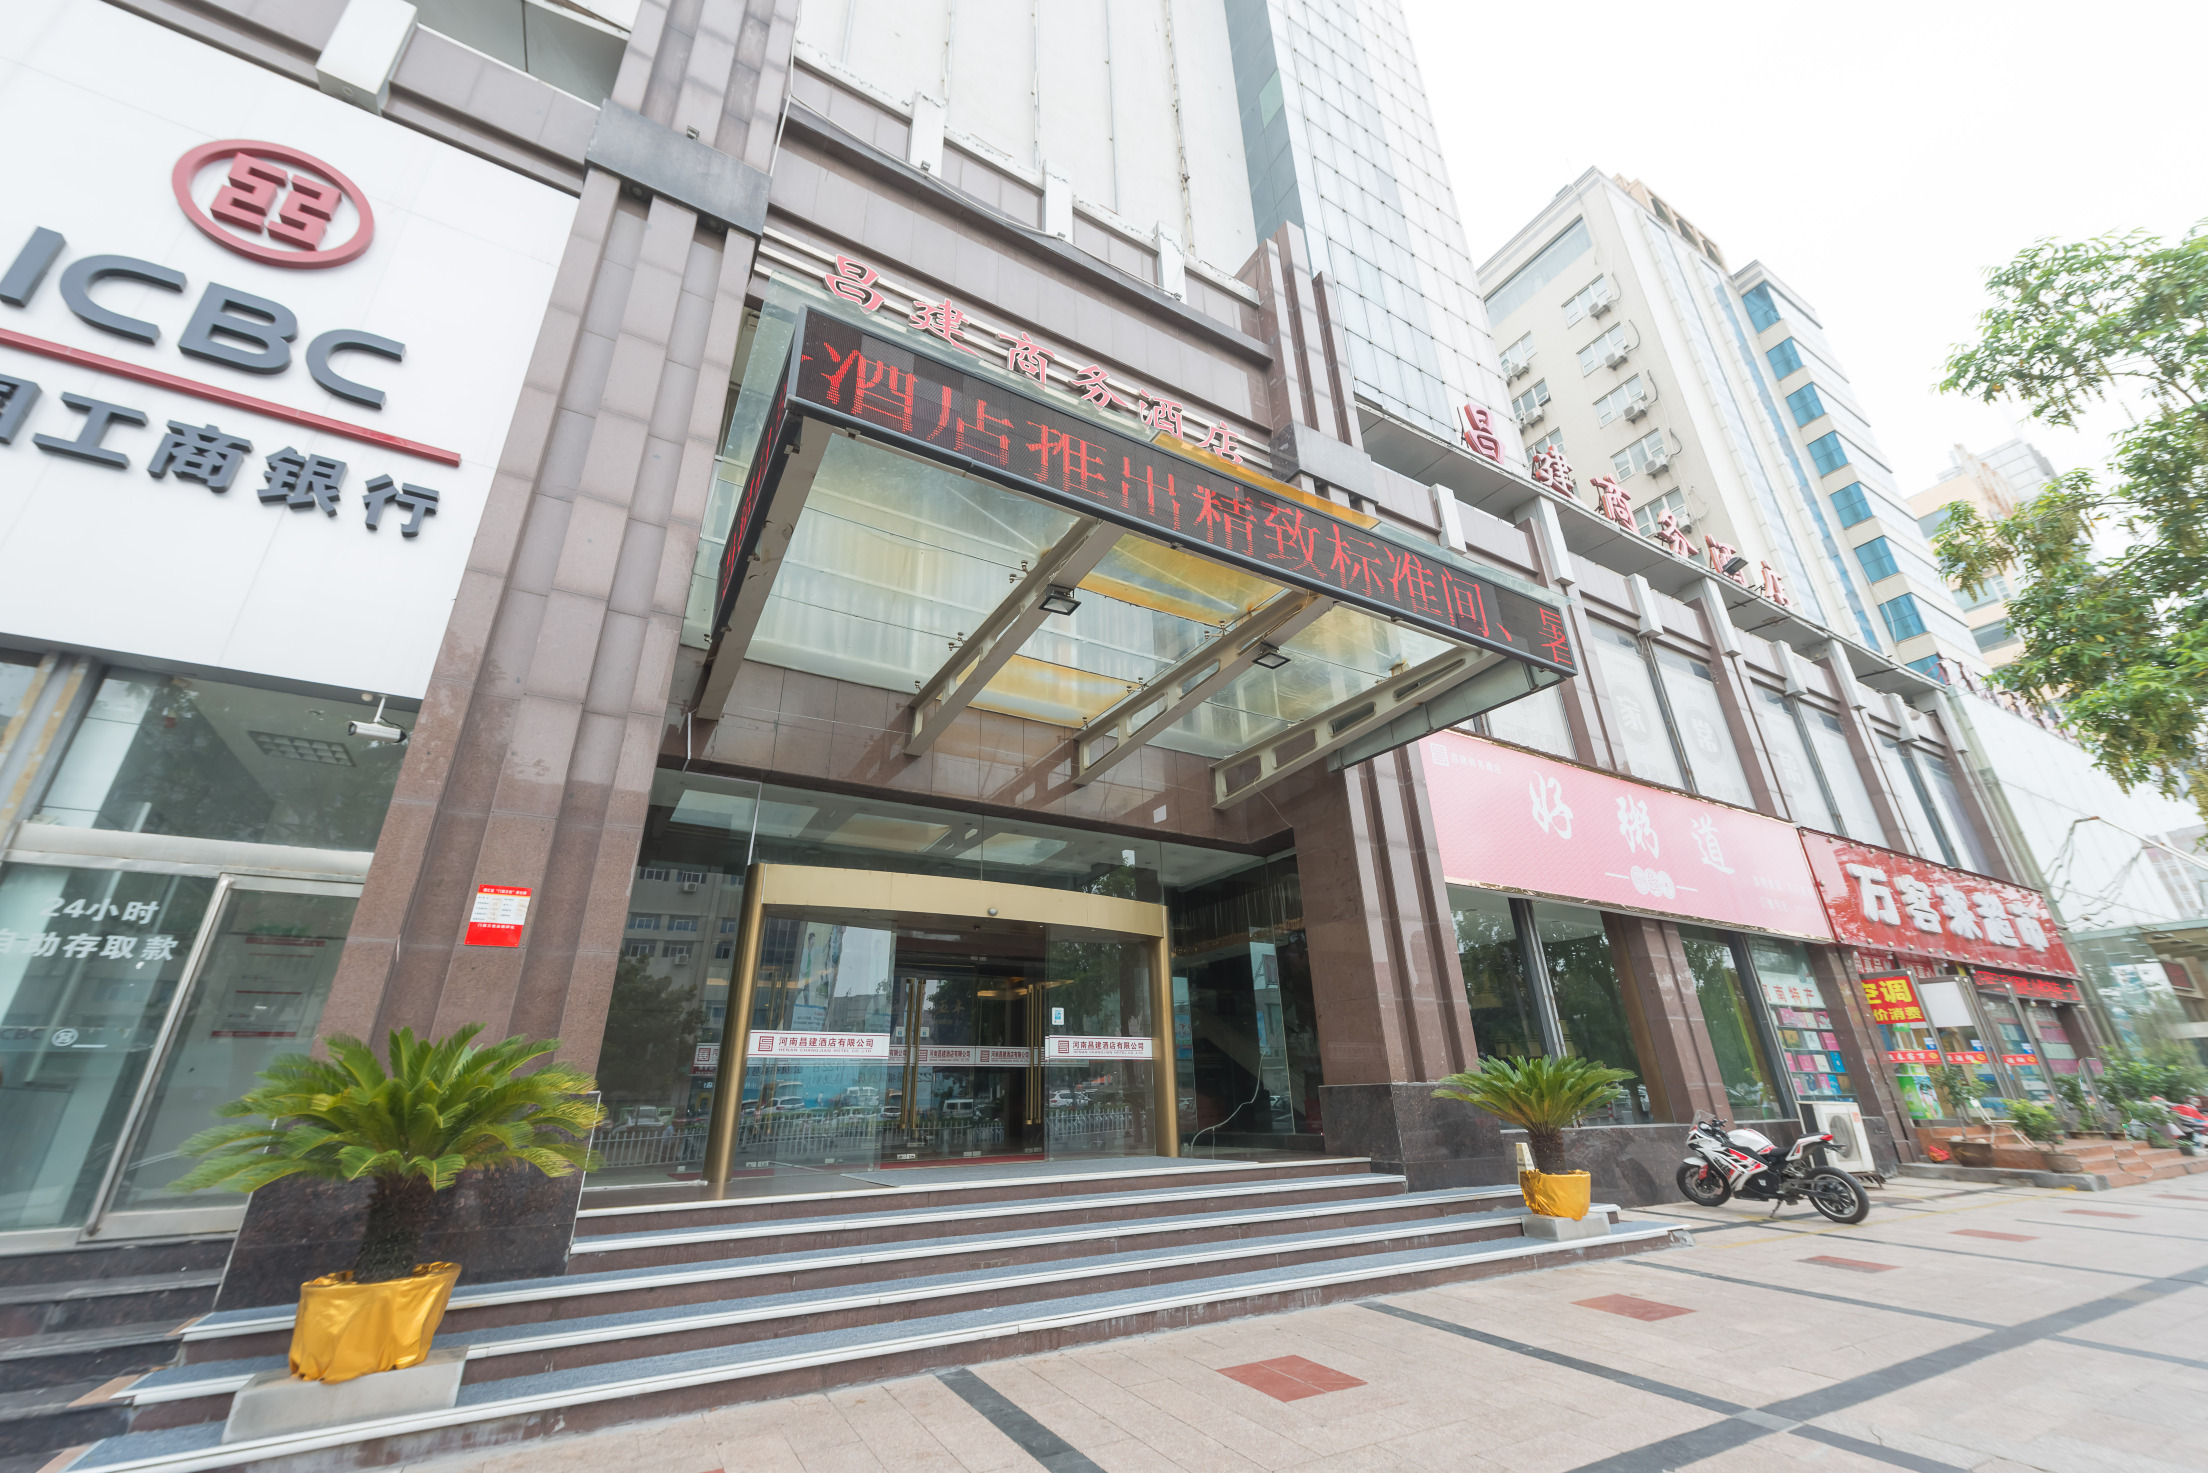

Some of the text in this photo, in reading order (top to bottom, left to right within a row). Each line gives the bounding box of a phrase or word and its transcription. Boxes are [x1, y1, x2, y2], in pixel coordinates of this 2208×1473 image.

[0, 226, 406, 410] ICBC
[823, 253, 1245, 465] 昌建商务酒店
[1464, 403, 1792, 608] 昌建商务酒店
[1528, 771, 1735, 875] 好粥道
[40, 898, 160, 925] 24小时
[1846, 863, 2050, 953] 万客来超市
[0, 928, 179, 961] 自助存取款
[1862, 979, 1913, 1005] 空调
[778, 1036, 874, 1048] 河南昌建酒店有限公司
[1072, 1040, 1144, 1050] 河南昌建酒店有限公司
